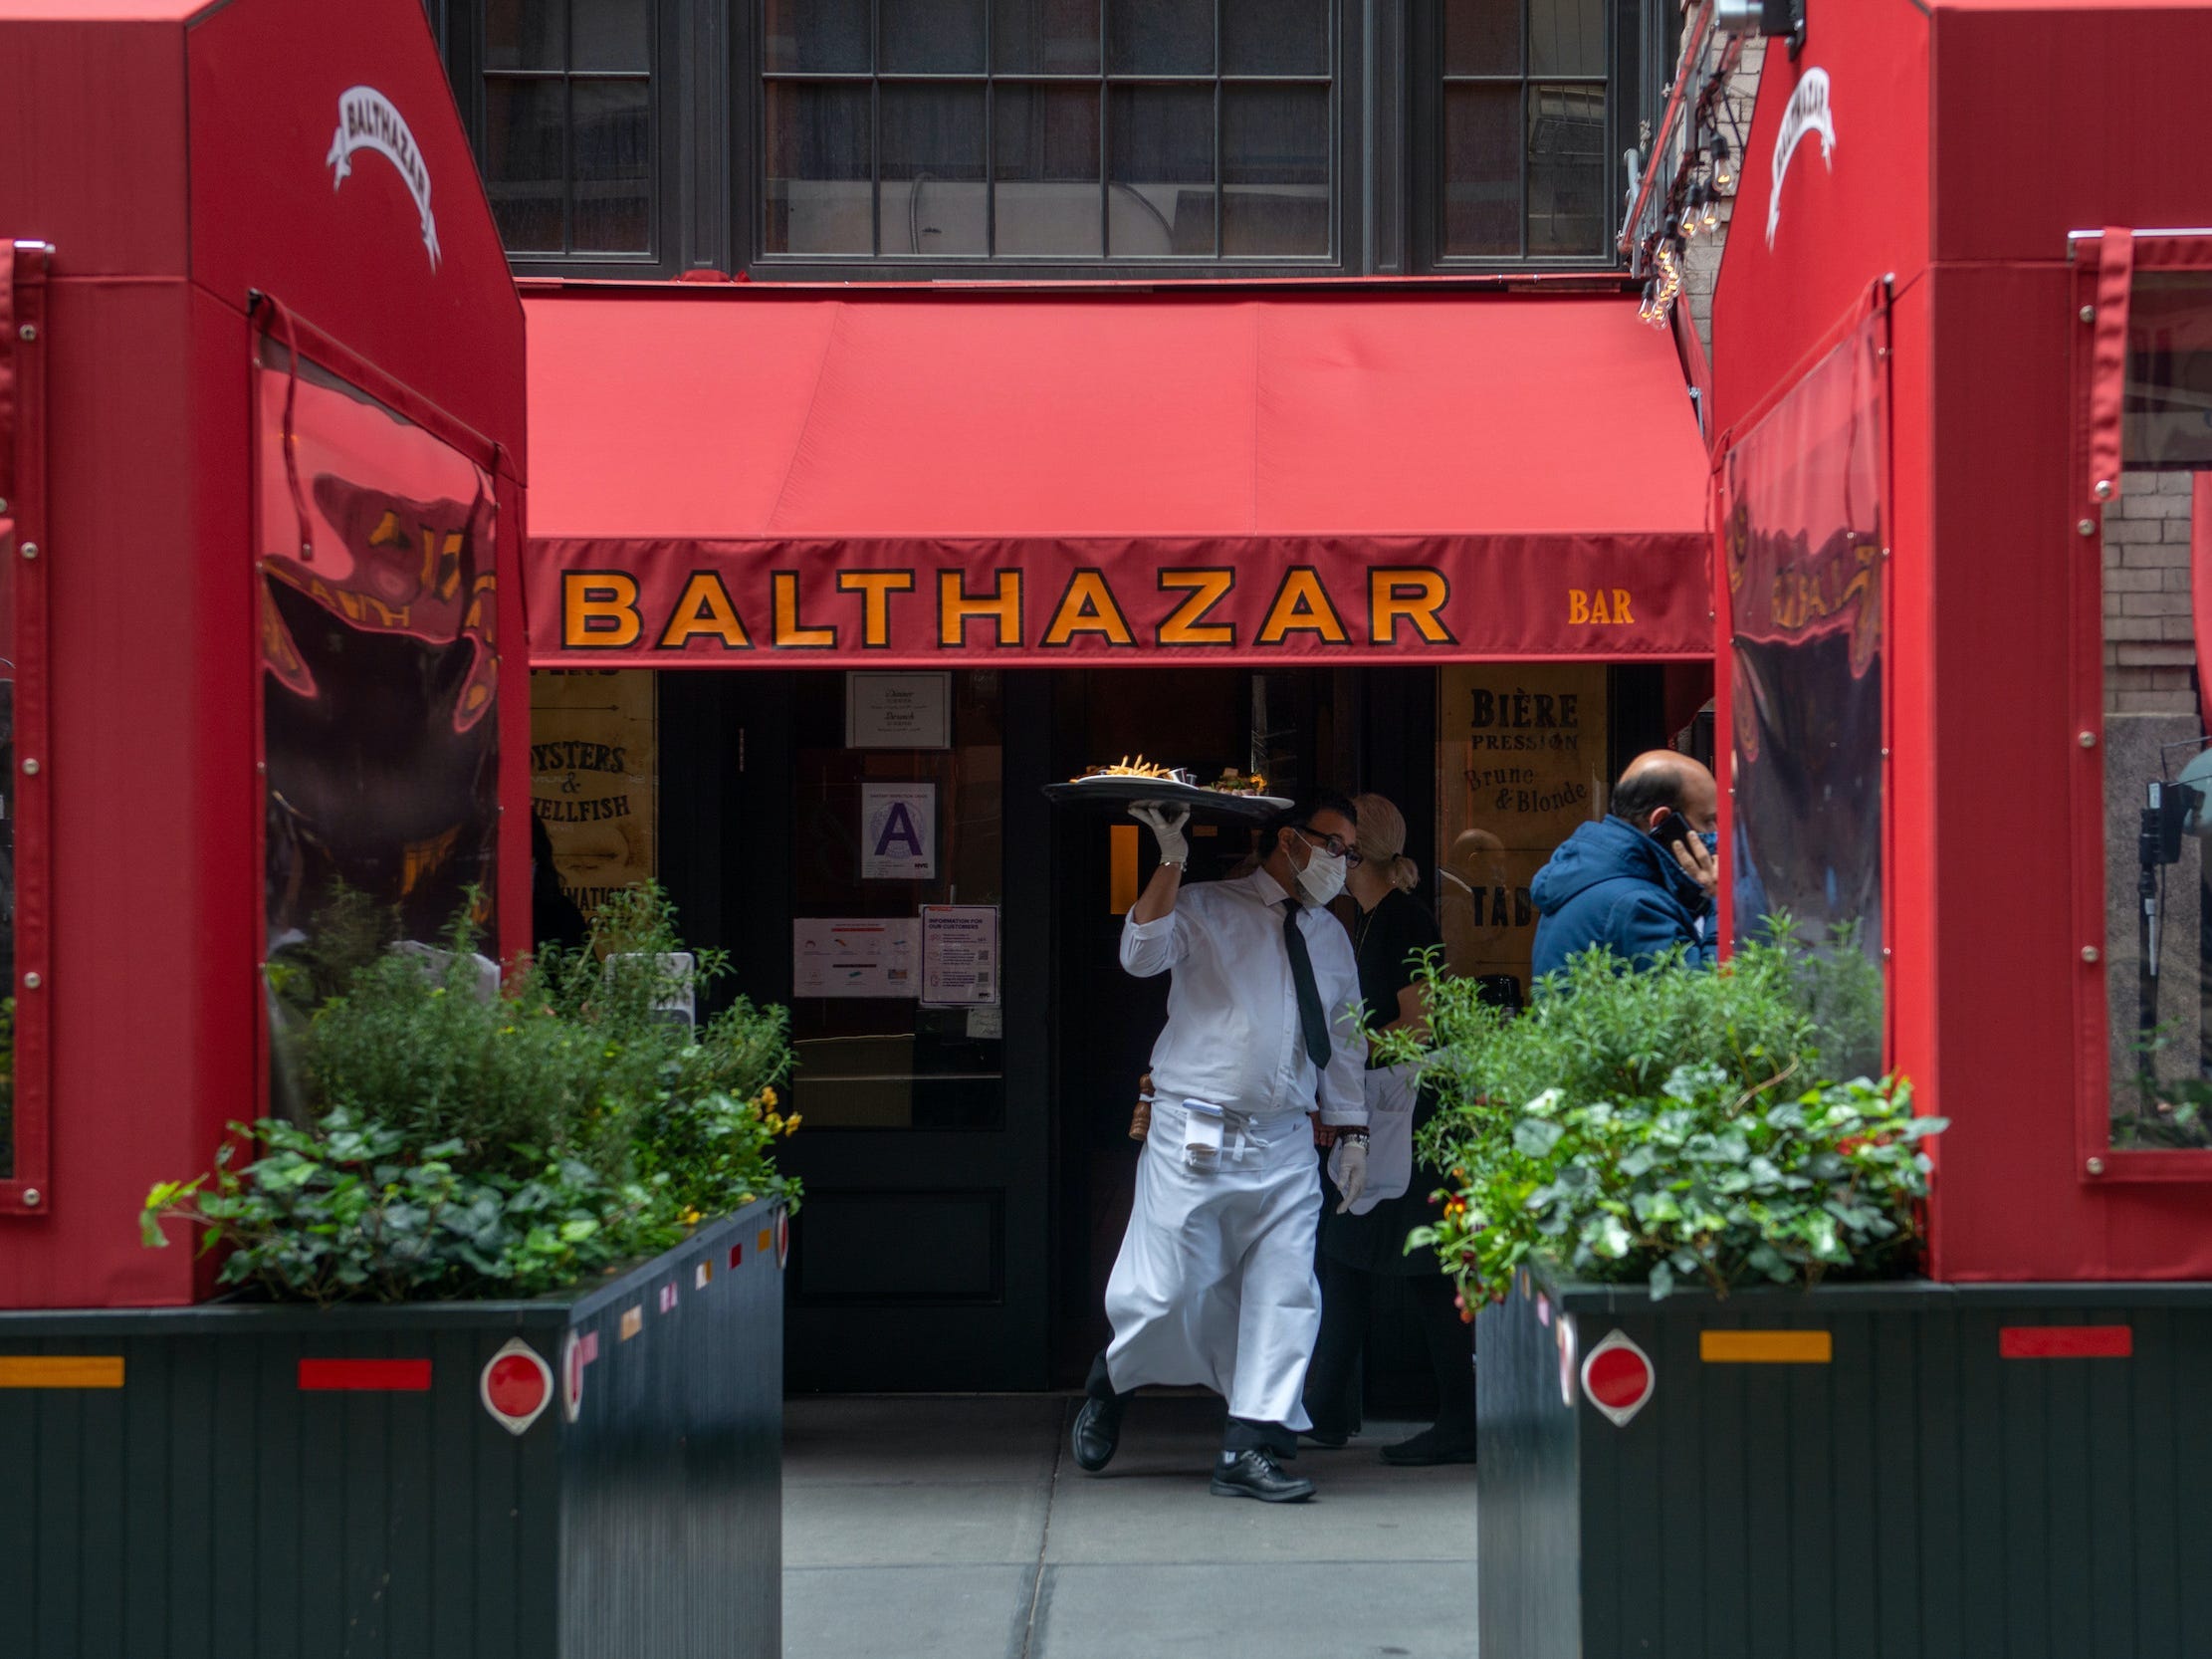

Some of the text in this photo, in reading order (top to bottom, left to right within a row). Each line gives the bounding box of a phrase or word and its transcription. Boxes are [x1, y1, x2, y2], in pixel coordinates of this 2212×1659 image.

[346, 98, 426, 195] BALTHAZAR
[561, 566, 1459, 650] BALTHAZAR
[1568, 588, 1635, 625] BAR
[1470, 687, 1579, 729] BIÈRE
[530, 740, 627, 774] YSTERS
[1470, 733, 1579, 752] PRESSION
[560, 771, 582, 795] &
[1464, 766, 1535, 793] Brune
[531, 794, 632, 824] ELLFISH
[873, 802, 924, 856] A
